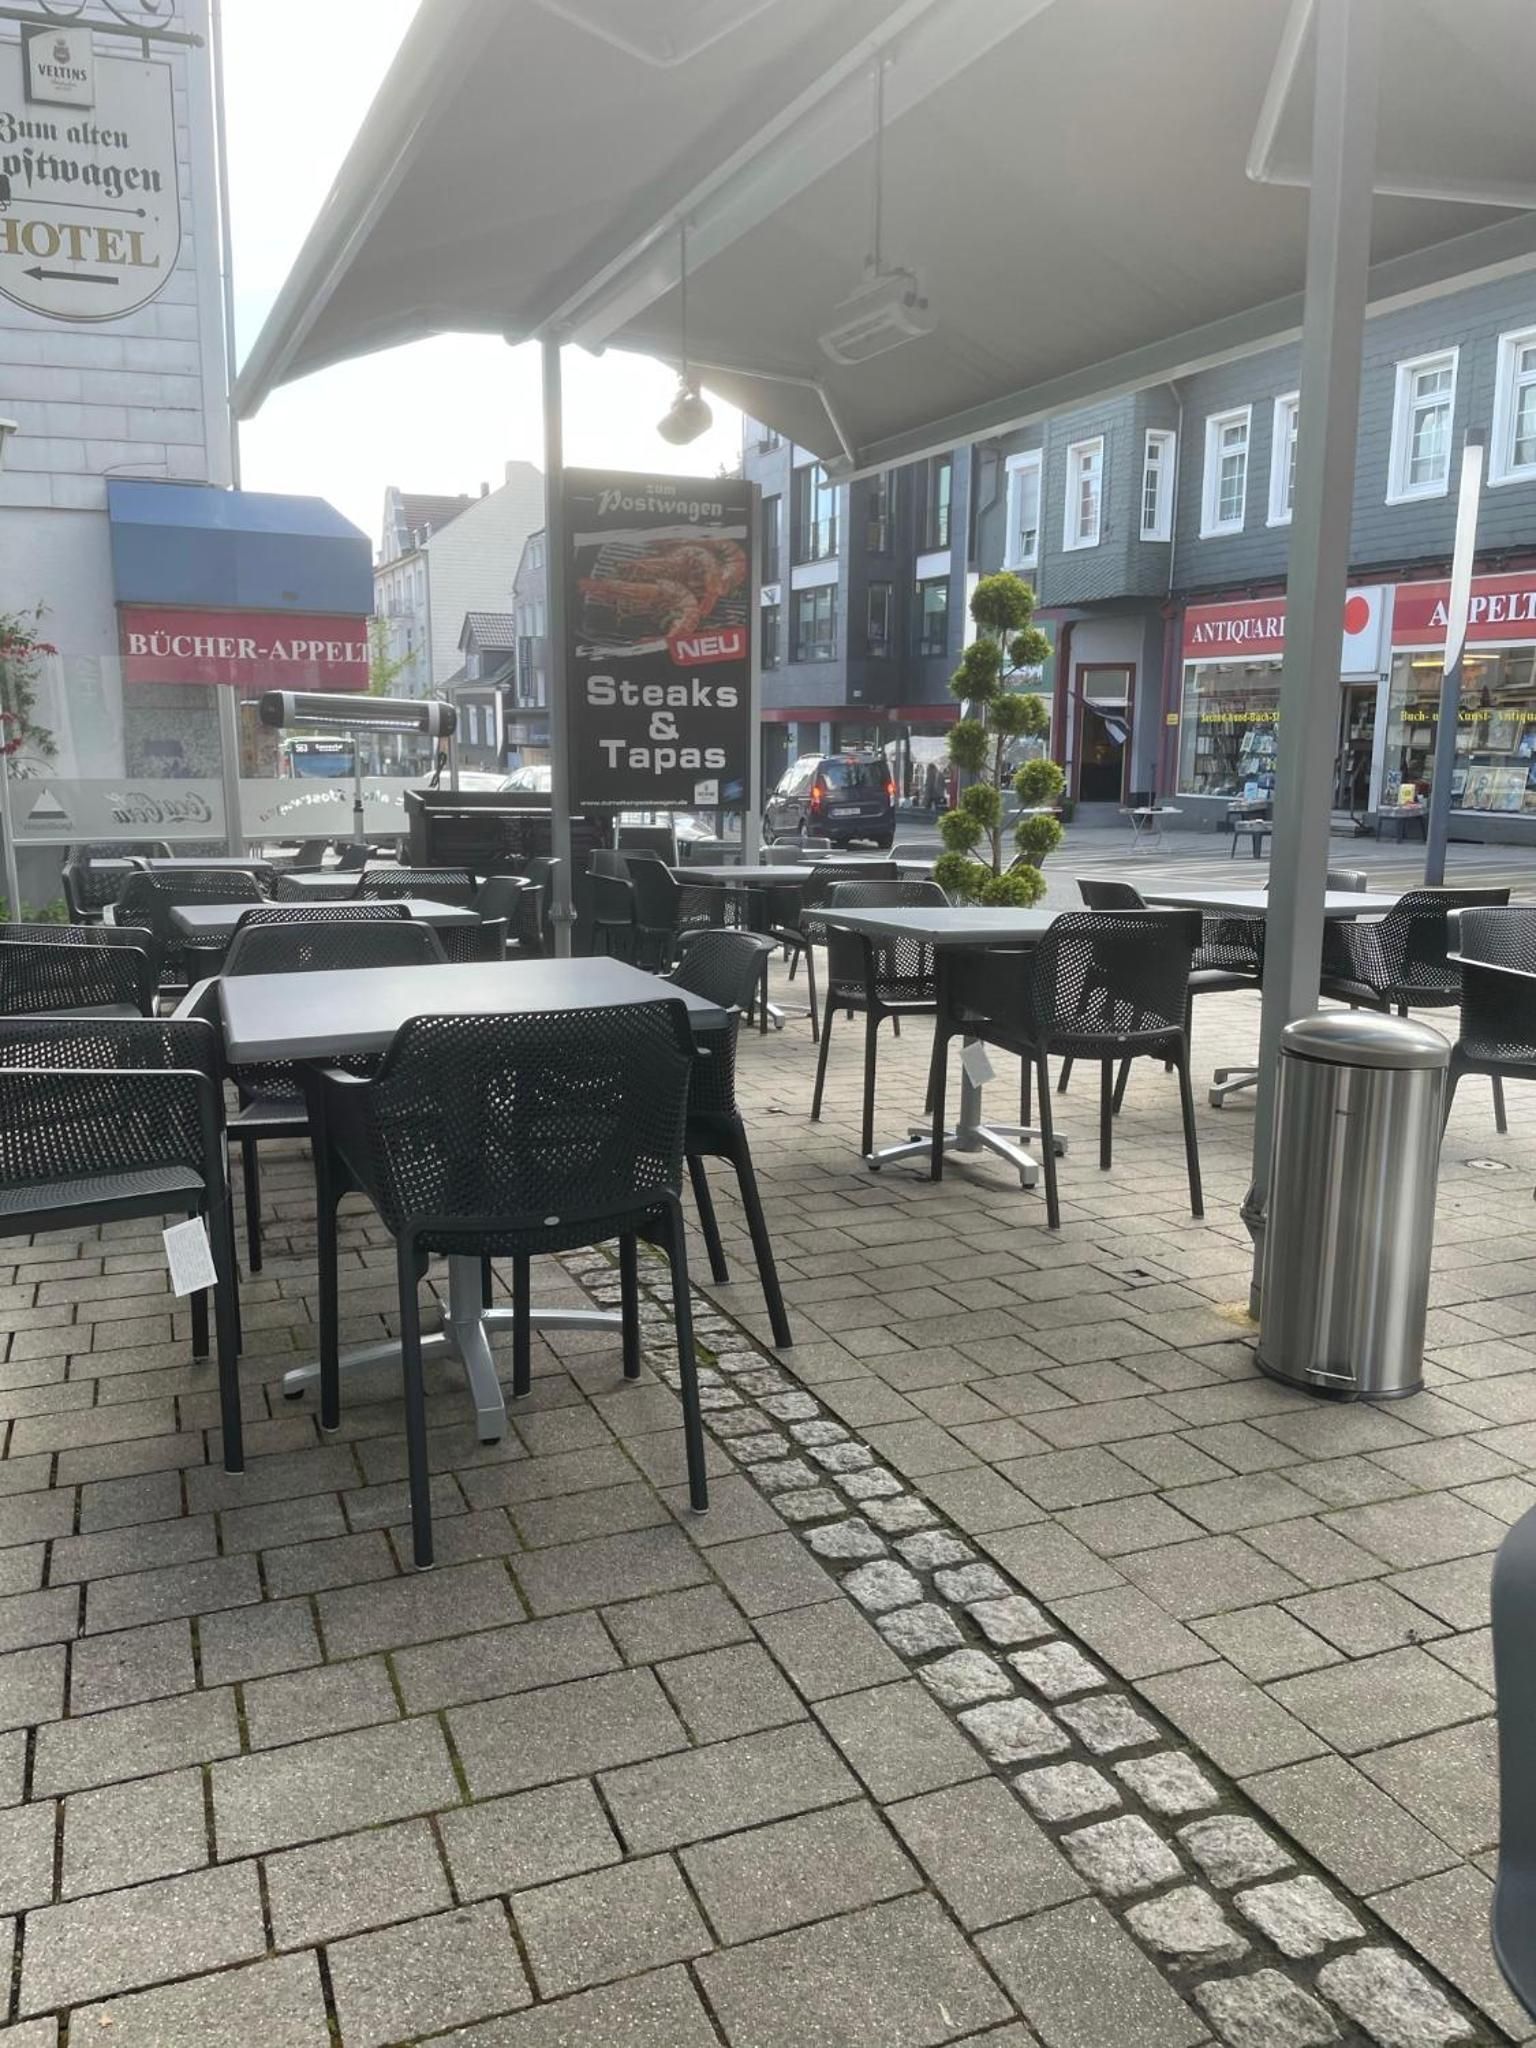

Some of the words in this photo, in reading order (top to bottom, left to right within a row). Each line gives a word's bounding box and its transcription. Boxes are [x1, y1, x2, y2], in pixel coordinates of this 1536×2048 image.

[38, 63, 87, 81] VELTINS
[0, 112, 57, 143] Zum
[66, 122, 128, 149] alten
[2, 147, 162, 199] ostwagen
[0, 217, 160, 268] HOTEL
[597, 488, 723, 522] Postwagen
[1428, 591, 1536, 626] APELT
[129, 629, 369, 664] BÜCHER-APPELT
[677, 633, 740, 660] NEU
[1192, 616, 1286, 644] ANTIQUARI
[586, 675, 738, 708] Steaks
[648, 711, 679, 741] &
[599, 739, 726, 774] Tapas
